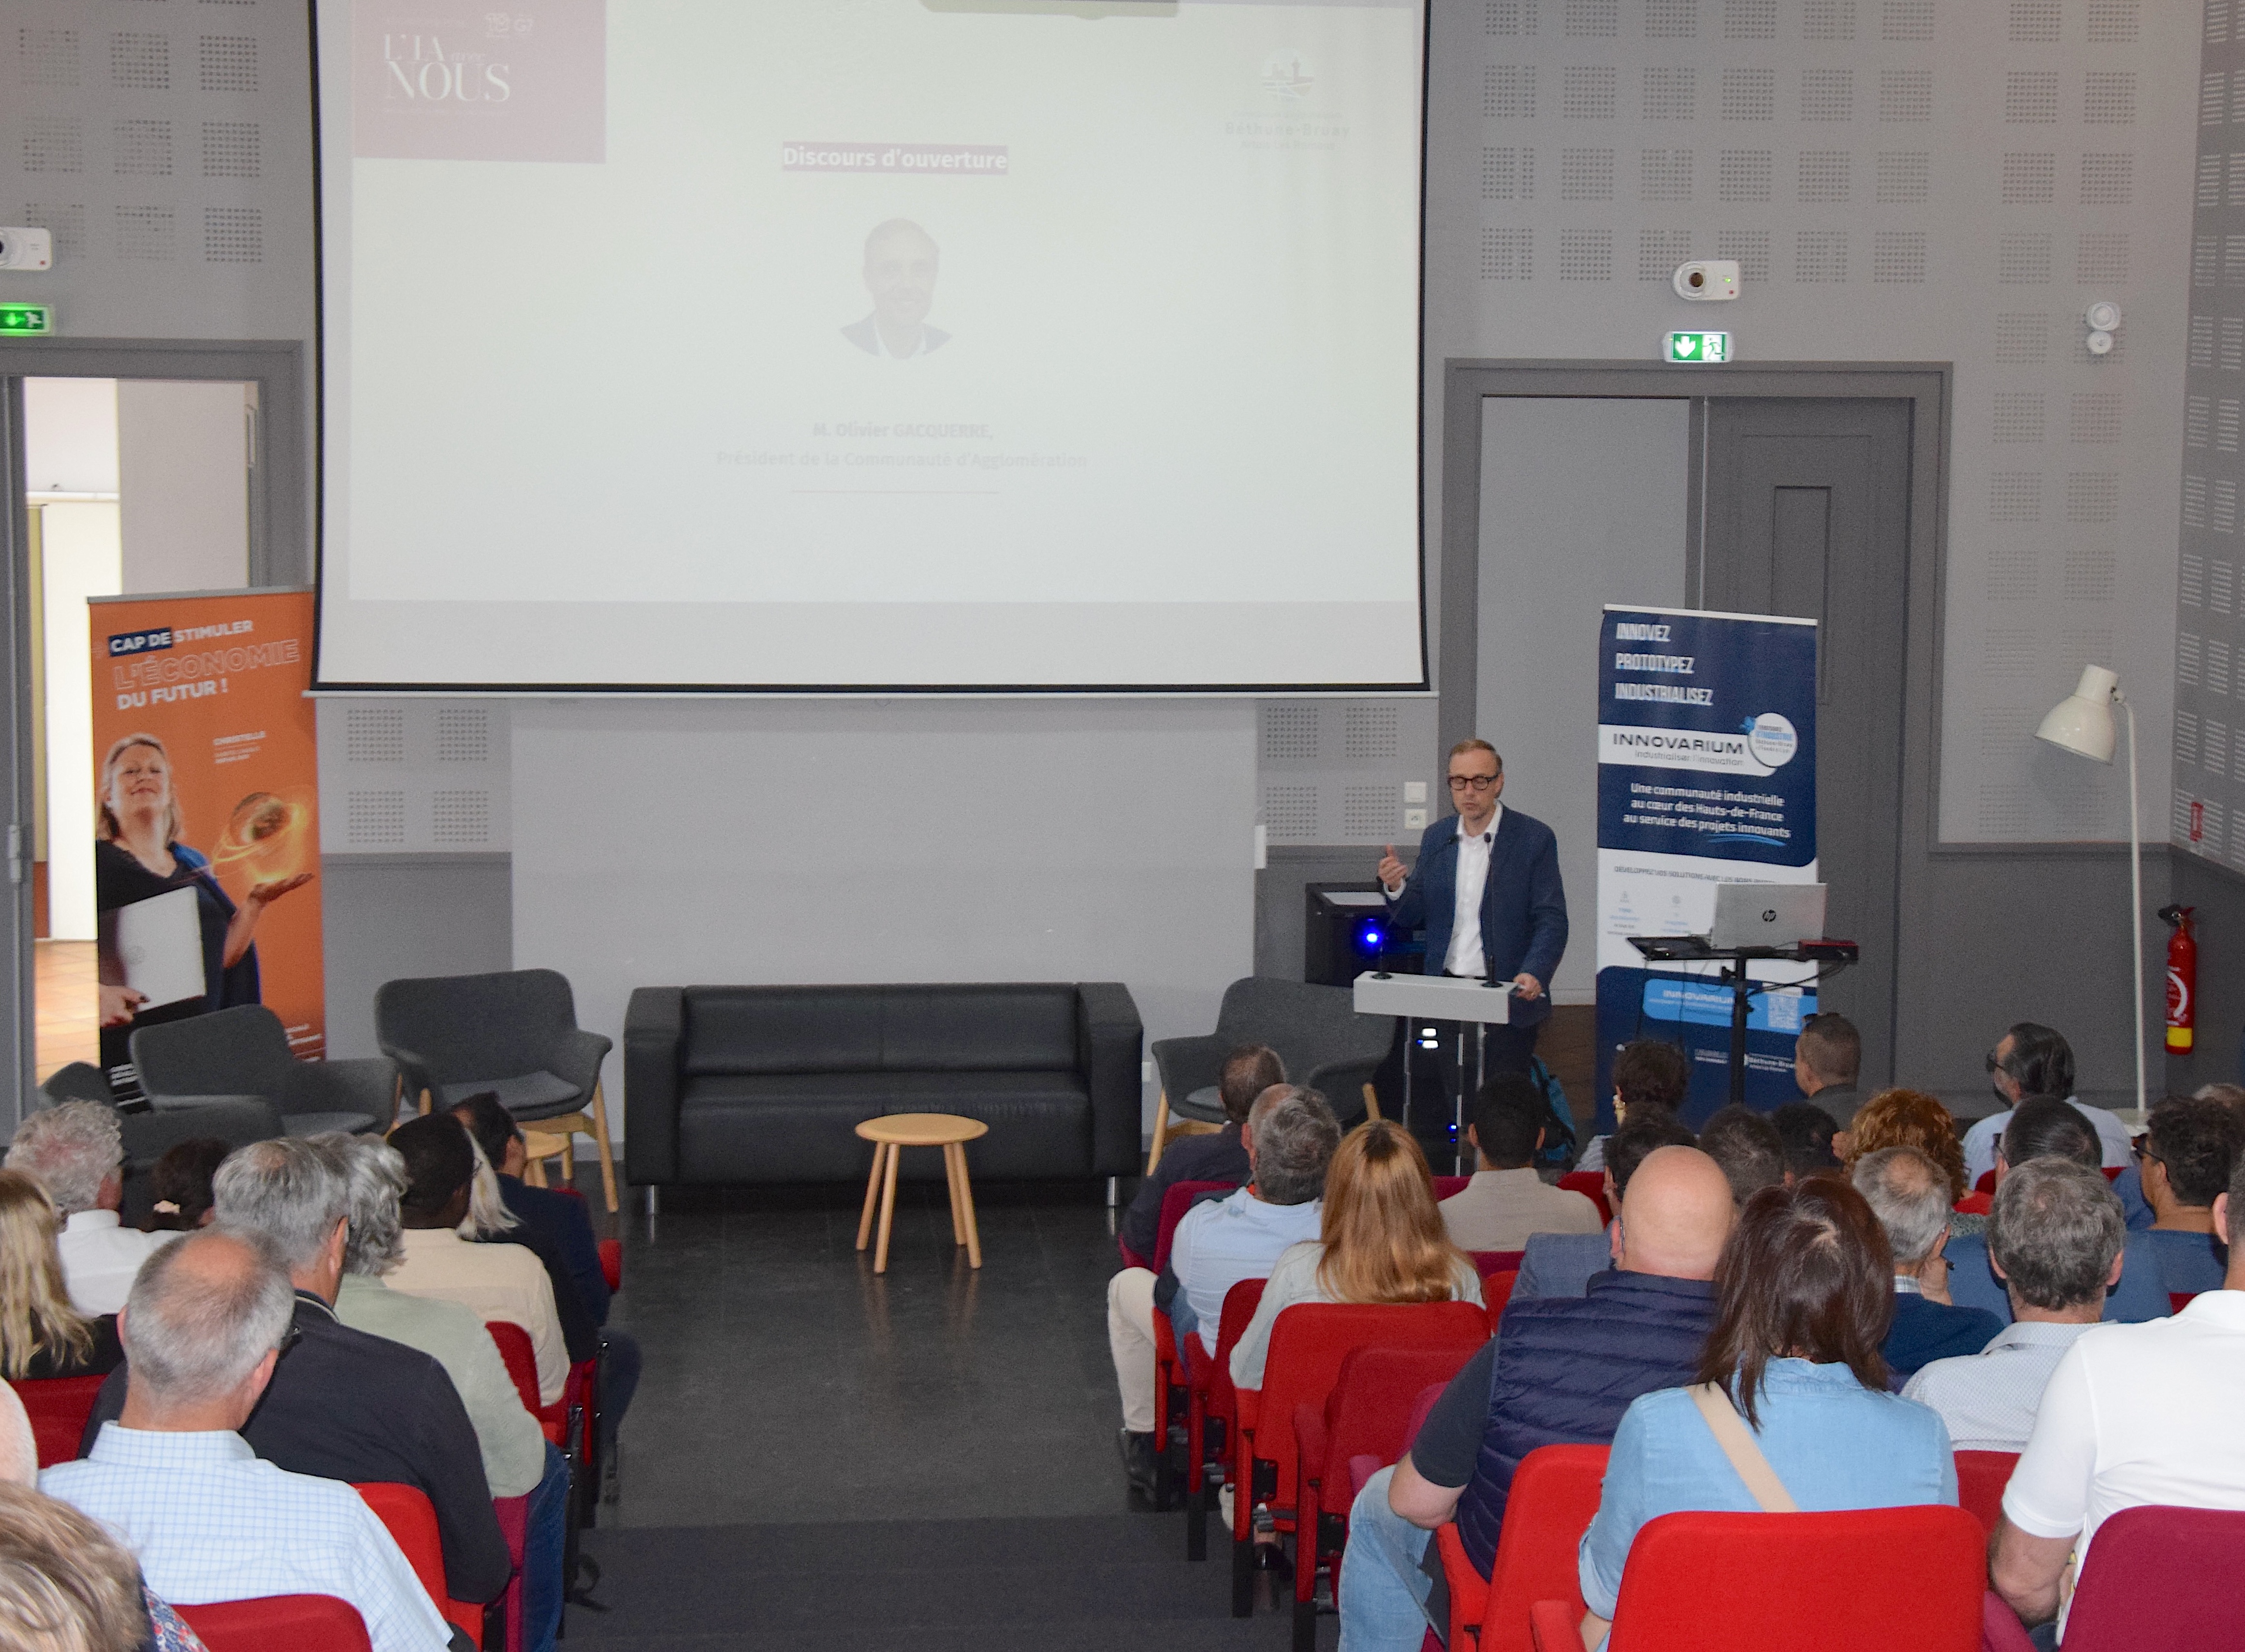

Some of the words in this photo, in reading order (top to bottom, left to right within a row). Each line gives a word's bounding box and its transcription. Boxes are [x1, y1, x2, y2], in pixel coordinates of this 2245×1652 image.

[384, 33, 445, 61] L'IA
[385, 60, 510, 102] NOUS
[784, 145, 876, 166] Discours
[882, 148, 1008, 169] d'ouverture
[813, 422, 831, 436] M.
[835, 421, 890, 437] Olivier
[716, 450, 796, 465] Président
[800, 450, 820, 466] de
[825, 451, 839, 465] la
[844, 452, 951, 467] Communauté
[956, 452, 1087, 470] d'Agglomération
[110, 635, 146, 654] CAP
[148, 631, 172, 648] DE
[174, 620, 253, 643] STIMULER
[1616, 622, 1671, 643] INNOVEZ
[113, 638, 301, 690] L'ÉCONOMIE
[1616, 652, 1695, 674] PROTOTYPEZ
[117, 692, 147, 710] DU
[150, 680, 218, 704] FUTUR
[221, 678, 229, 693] !
[1615, 682, 1714, 706] INDUSTRIALISEZ
[1612, 733, 1744, 754] INNOVARIUM
[1631, 782, 1652, 794] Une
[1653, 785, 1722, 801] communauté
[1724, 790, 1785, 807] industrielle
[1631, 799, 1645, 809] au
[1646, 801, 1674, 811] cœur
[1675, 802, 1695, 813] des
[1696, 804, 1784, 822] Hauts-de-France
[1623, 814, 1638, 823] au
[1639, 815, 1677, 826] service
[1678, 817, 1698, 829] des
[1699, 820, 1737, 833] projets
[1738, 822, 1792, 838] innovants
